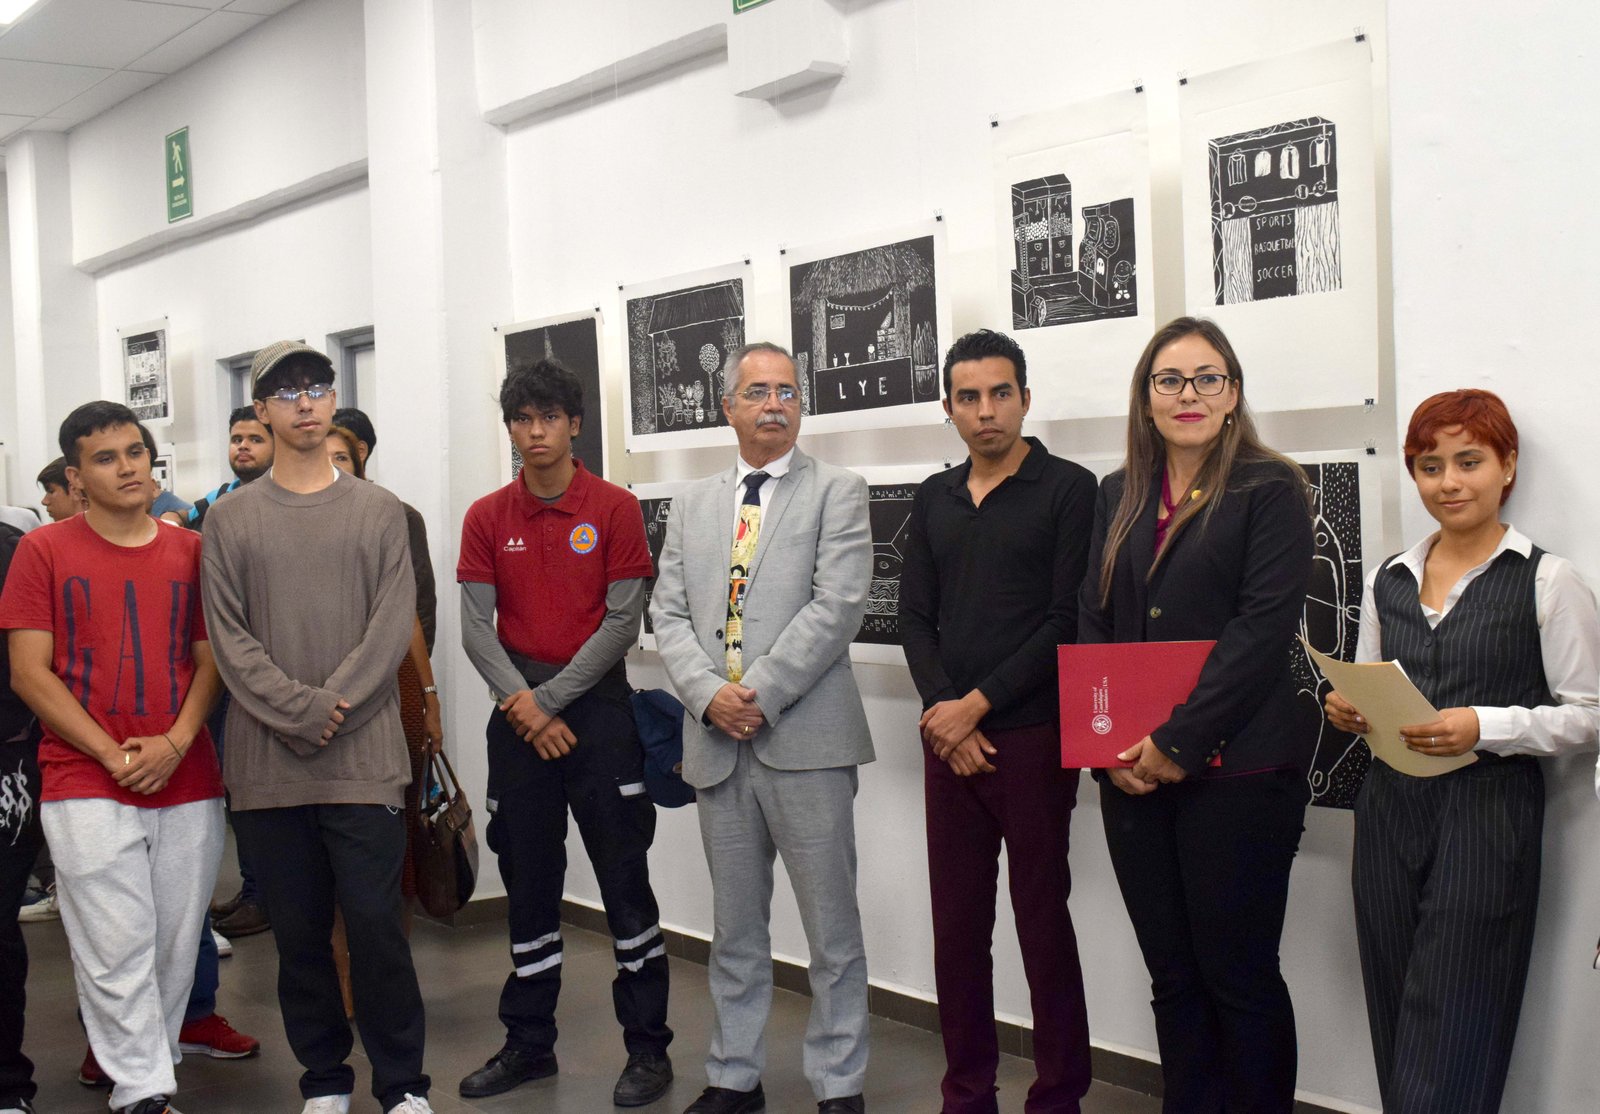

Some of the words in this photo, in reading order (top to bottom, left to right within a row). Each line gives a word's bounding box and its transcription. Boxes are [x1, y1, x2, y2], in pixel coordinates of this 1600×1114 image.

[1256, 213, 1292, 230] SPORTS
[1256, 264, 1294, 282] SOCCER
[838, 376, 888, 400] LYE
[63, 575, 197, 716] GAP
